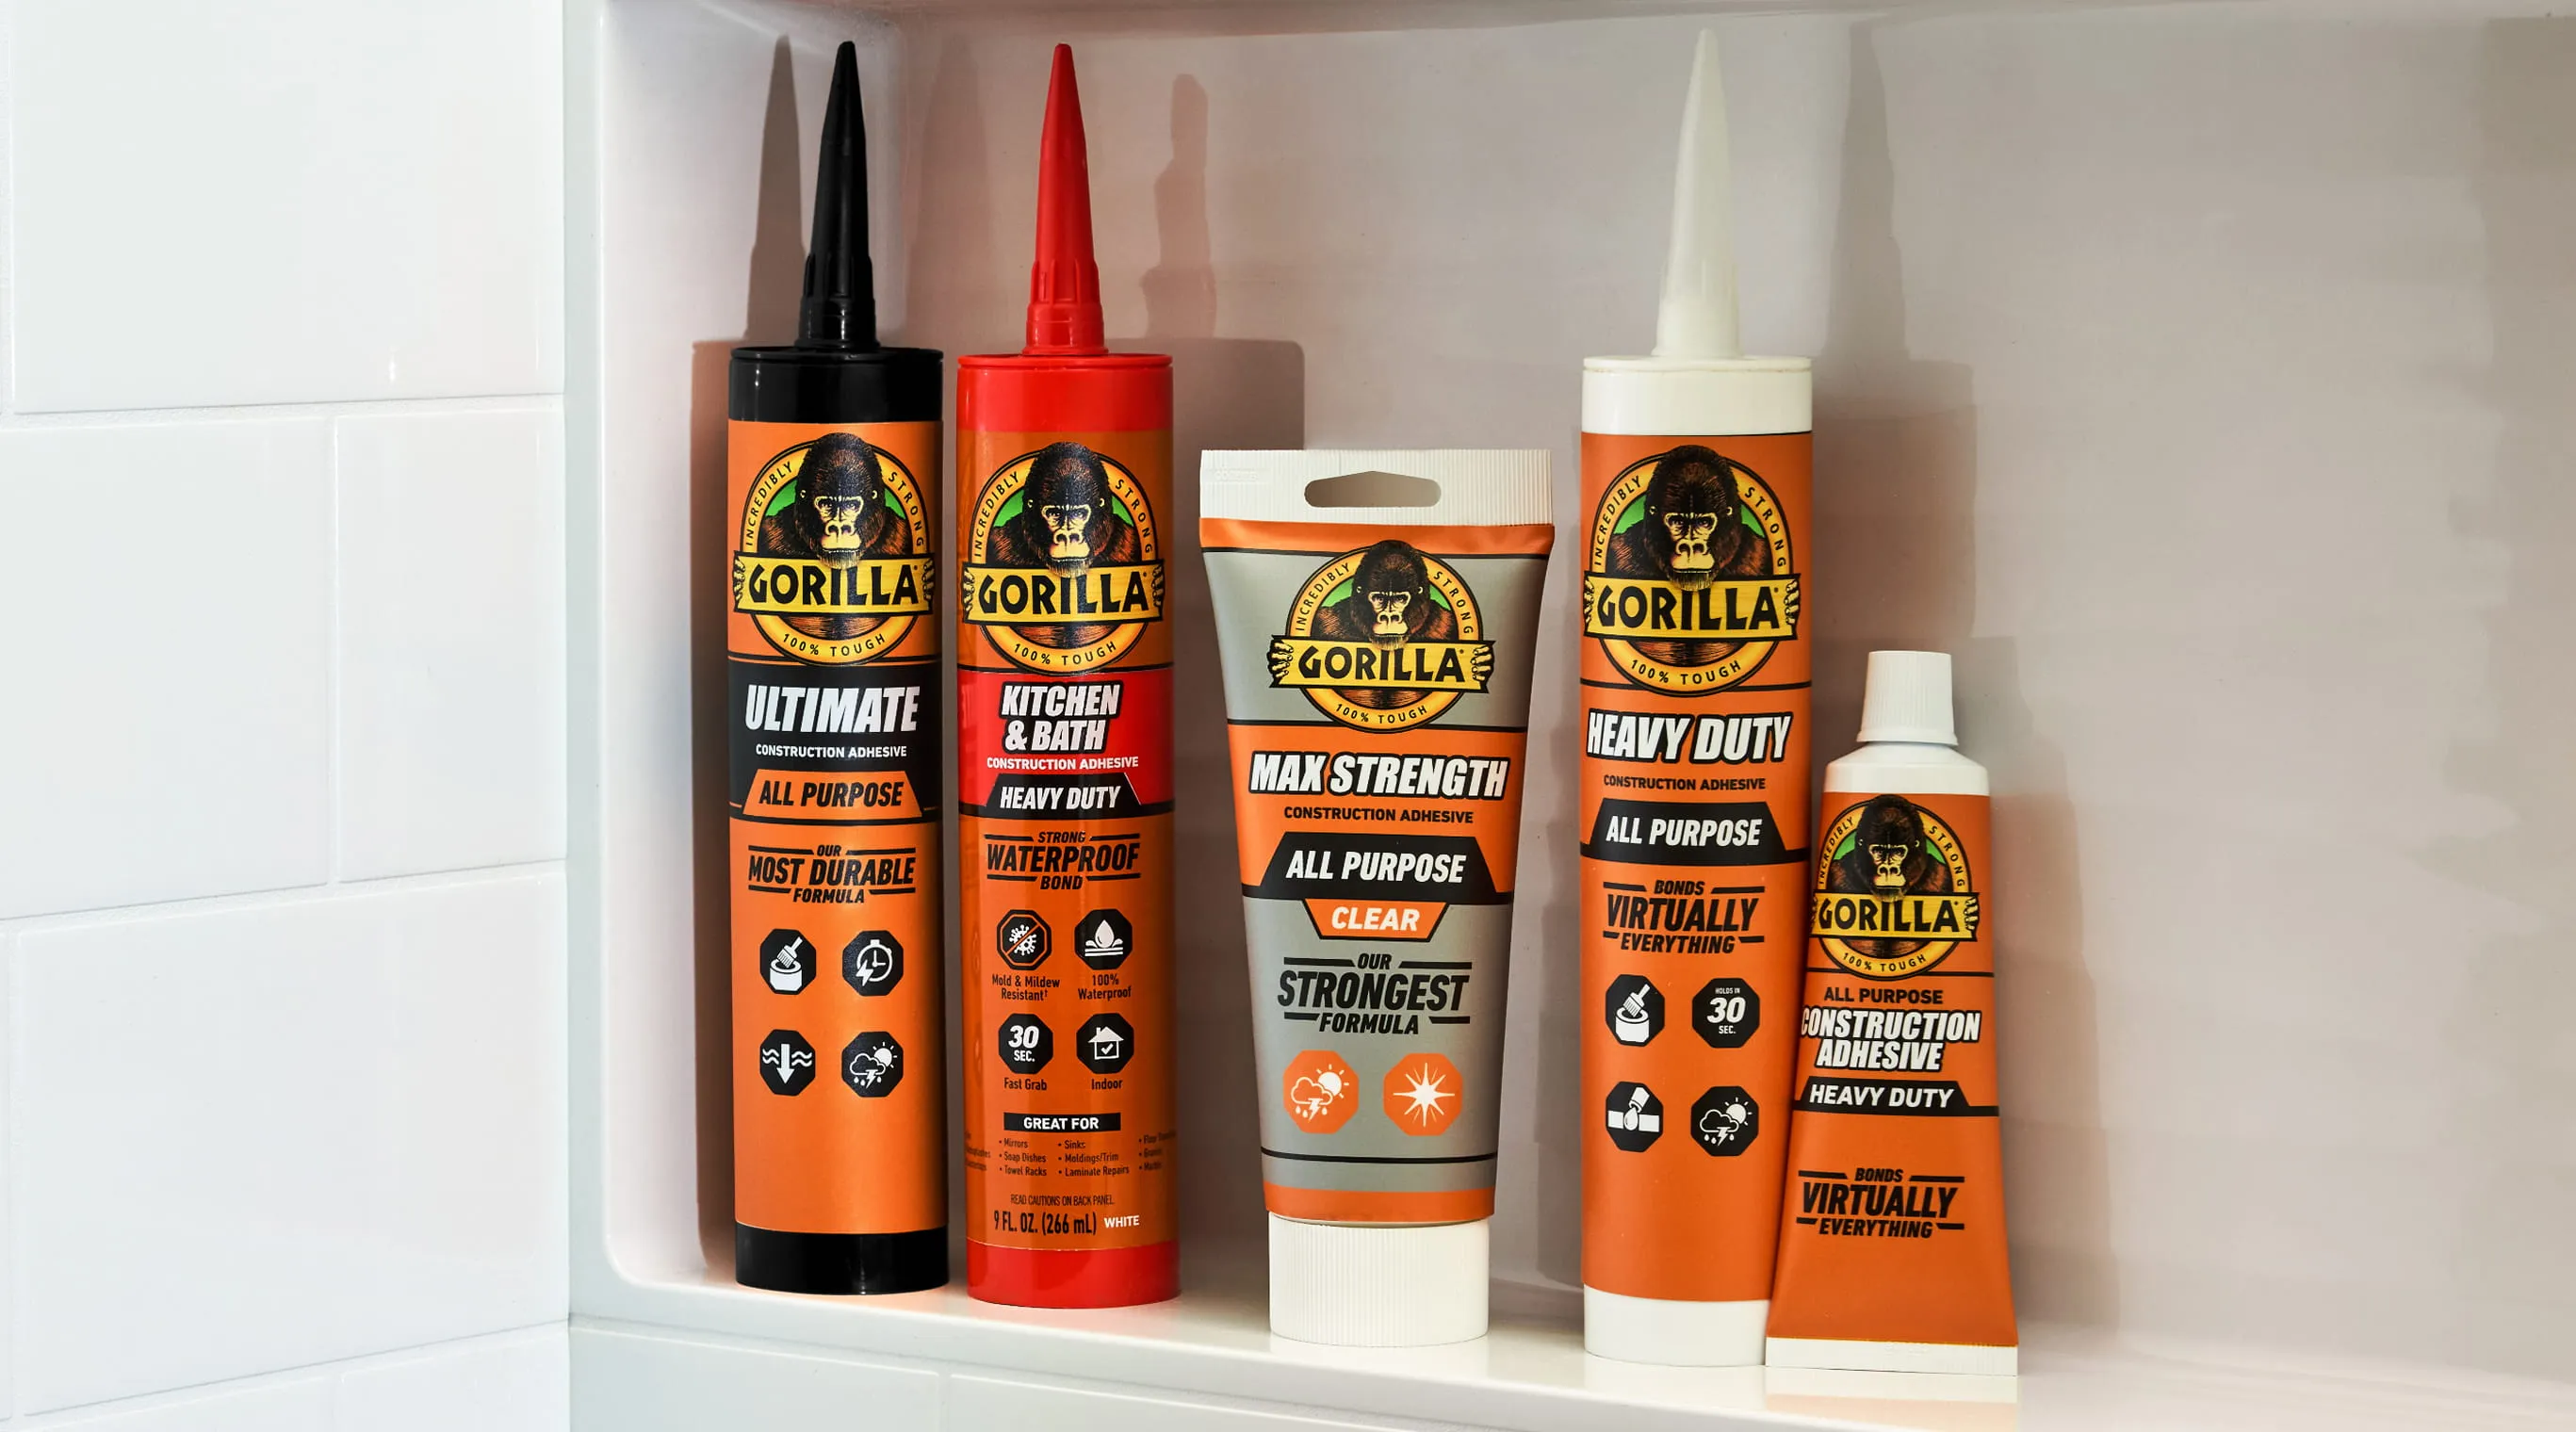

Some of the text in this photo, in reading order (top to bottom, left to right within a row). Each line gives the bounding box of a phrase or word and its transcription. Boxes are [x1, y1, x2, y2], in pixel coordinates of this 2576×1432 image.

[745, 461, 924, 546] INCREDIBLY STRONG
[974, 471, 1153, 557] INCREDIBLY STRONG
[1594, 475, 1786, 567] INCREDIBLY STRONG
[748, 564, 919, 606] GORILLA
[978, 571, 1149, 615] GORILLA
[1296, 562, 1474, 634] INCREDIBLY STRONG
[1597, 585, 1780, 630] GORILLA
[783, 633, 886, 657] 100% TOUGH
[1014, 641, 1117, 665] 100% TOUGH
[1298, 646, 1465, 682] GORILLA
[1631, 659, 1741, 685] 100% TOUGH
[745, 684, 920, 733] ULTIMATE
[1002, 685, 1120, 716] KITCHEN
[1336, 703, 1427, 724] 100% TOUGH
[1004, 720, 1105, 751] & BATH
[1587, 712, 1791, 760] HEAVY DUTY
[756, 743, 906, 758] CONSTRUCTION ADHESIVE
[987, 757, 1138, 770] CONSTRUCTION ADHESIVE
[1250, 754, 1508, 797] MAX STRENGTH
[1604, 774, 1766, 789] CONSTRUCTION ADHESIVE
[758, 780, 905, 807] ALL PURPOSE
[1000, 786, 1120, 809] HEAVY DUTY
[1284, 806, 1474, 823] CONSTRUCTION ADHESIVE
[1037, 832, 1085, 842] STRONG
[1606, 815, 1763, 846] ALL PURPOSE
[817, 845, 841, 857] OUR
[987, 843, 1141, 872] WATERPROOF
[1819, 817, 1965, 887] INCREDIBLY STRONG
[748, 855, 916, 886] MOST DURABLE
[1286, 850, 1467, 884] ALL PURPOSE
[1040, 875, 1083, 890] BOND
[1654, 880, 1705, 895] BONDS
[792, 888, 864, 903] FORMULA
[1331, 906, 1420, 931] CLEAR
[1607, 894, 1759, 932] VIRTUALLY
[1818, 898, 1960, 932] GORILLA
[1621, 933, 1735, 953] EVERYTHING
[1358, 953, 1392, 969] OUR
[1843, 952, 1926, 972] 100% TOUGH
[992, 974, 1060, 988] Mold & Mildew
[1092, 974, 1118, 985] 100%
[1278, 970, 1470, 1011] STRONGEST
[1078, 985, 1132, 1001] Waterproof
[1824, 987, 1944, 1004] ALL PURPOSE
[1706, 997, 1746, 1023] 30
[1319, 1013, 1419, 1034] FORMULA
[1719, 1025, 1736, 1033] SEC.
[1802, 1008, 1981, 1041] CONSTRUCTION
[1008, 1025, 1039, 1048] 30
[1014, 1050, 1035, 1062] SEC.
[1817, 1039, 1944, 1070] ADHESIVE
[1004, 1078, 1047, 1090] Fast Grab
[1091, 1079, 1123, 1089] Indoor
[1810, 1084, 1954, 1108] HEAVY DUTY
[1023, 1117, 1099, 1130] GREAT FOR
[1004, 1138, 1028, 1148] Mirrors
[1065, 1140, 1085, 1149] Sinks
[1004, 1151, 1046, 1163] Soap Dishes
[1065, 1153, 1118, 1164] Moldings/Trim
[1004, 1165, 1047, 1176] Towel Racks
[1102, 1165, 1129, 1176] Repairs
[1855, 1168, 1903, 1181] BONDS
[1011, 1195, 1026, 1204] READ
[1028, 1196, 1060, 1206] CAUTIONS
[1063, 1196, 1071, 1206] ON
[1074, 1196, 1091, 1206] BACK
[1803, 1182, 1958, 1218] VIRTUALLY
[994, 1210, 1097, 1236] 9 FL. OZ. (266 mL)
[1104, 1215, 1139, 1228] WHITE
[1818, 1218, 1932, 1238] EVERYTHING
